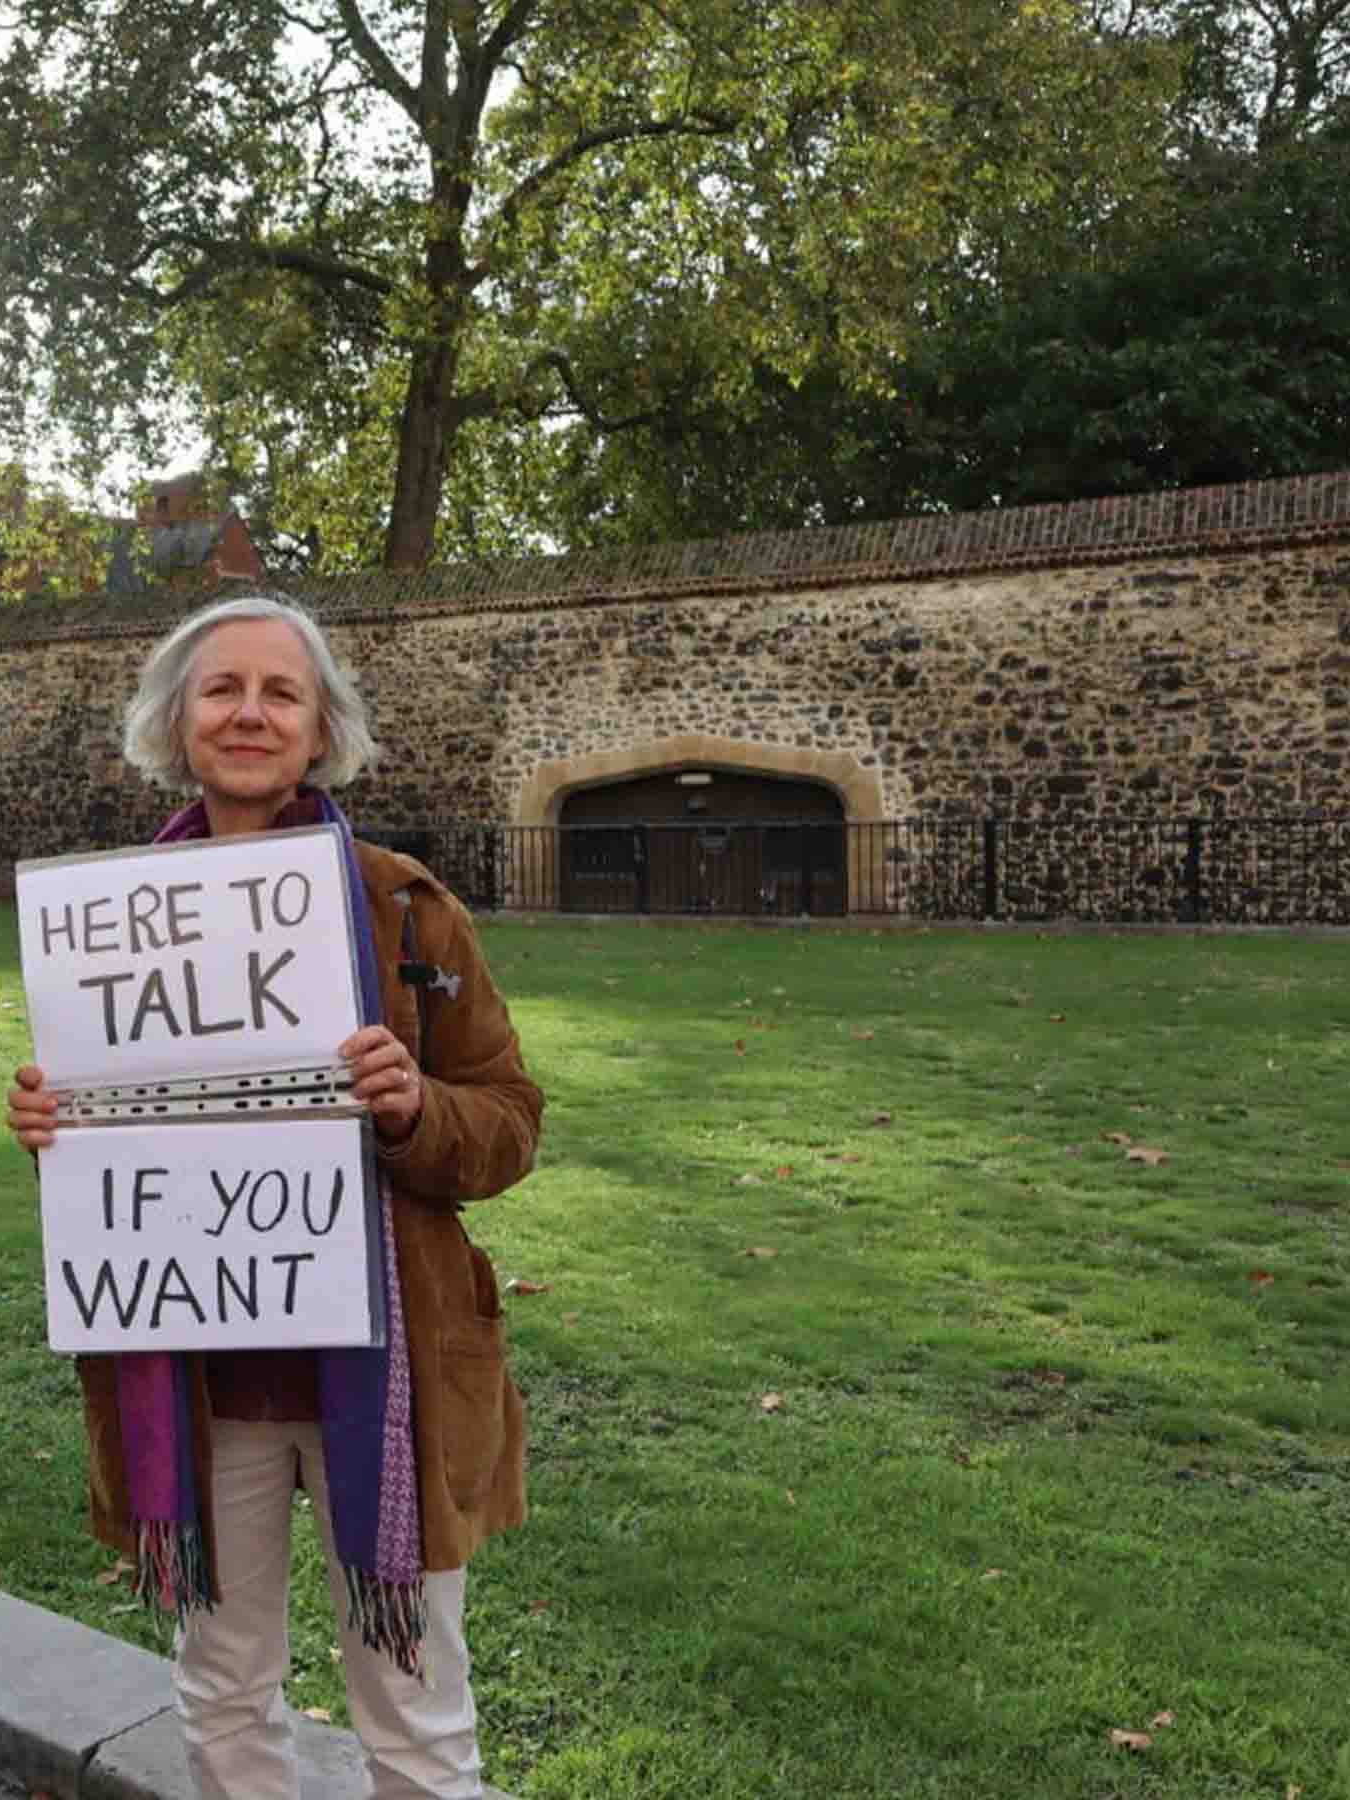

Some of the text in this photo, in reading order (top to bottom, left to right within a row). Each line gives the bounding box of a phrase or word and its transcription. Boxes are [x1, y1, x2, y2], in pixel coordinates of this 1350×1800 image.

[40, 871, 312, 956] HERE TO
[79, 948, 301, 1047] TALK
[102, 1166, 344, 1237] IF YOU
[61, 1252, 315, 1330] WANT
